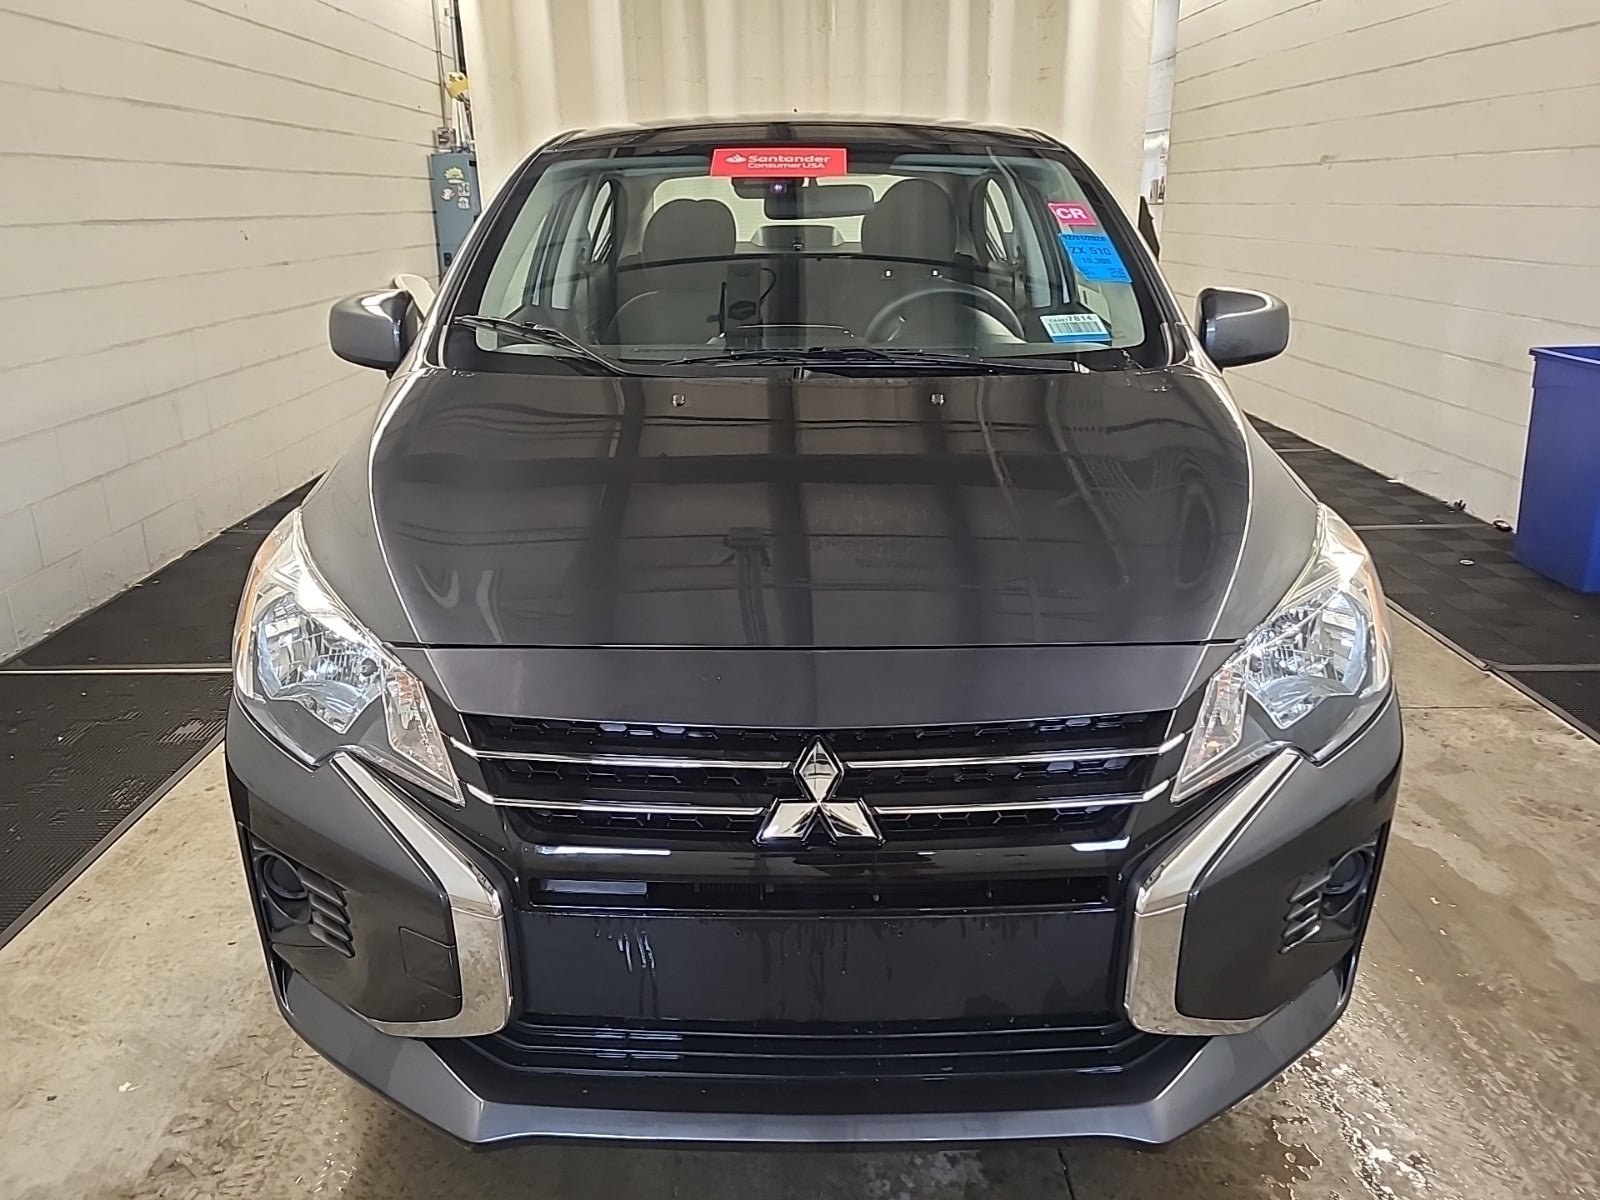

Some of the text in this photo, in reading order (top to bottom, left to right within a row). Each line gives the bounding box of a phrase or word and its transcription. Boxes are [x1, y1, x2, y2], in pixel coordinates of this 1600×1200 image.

[748, 155, 831, 163] Santander
[1056, 207, 1087, 220] CR
[1069, 246, 1111, 256] ZX 510
